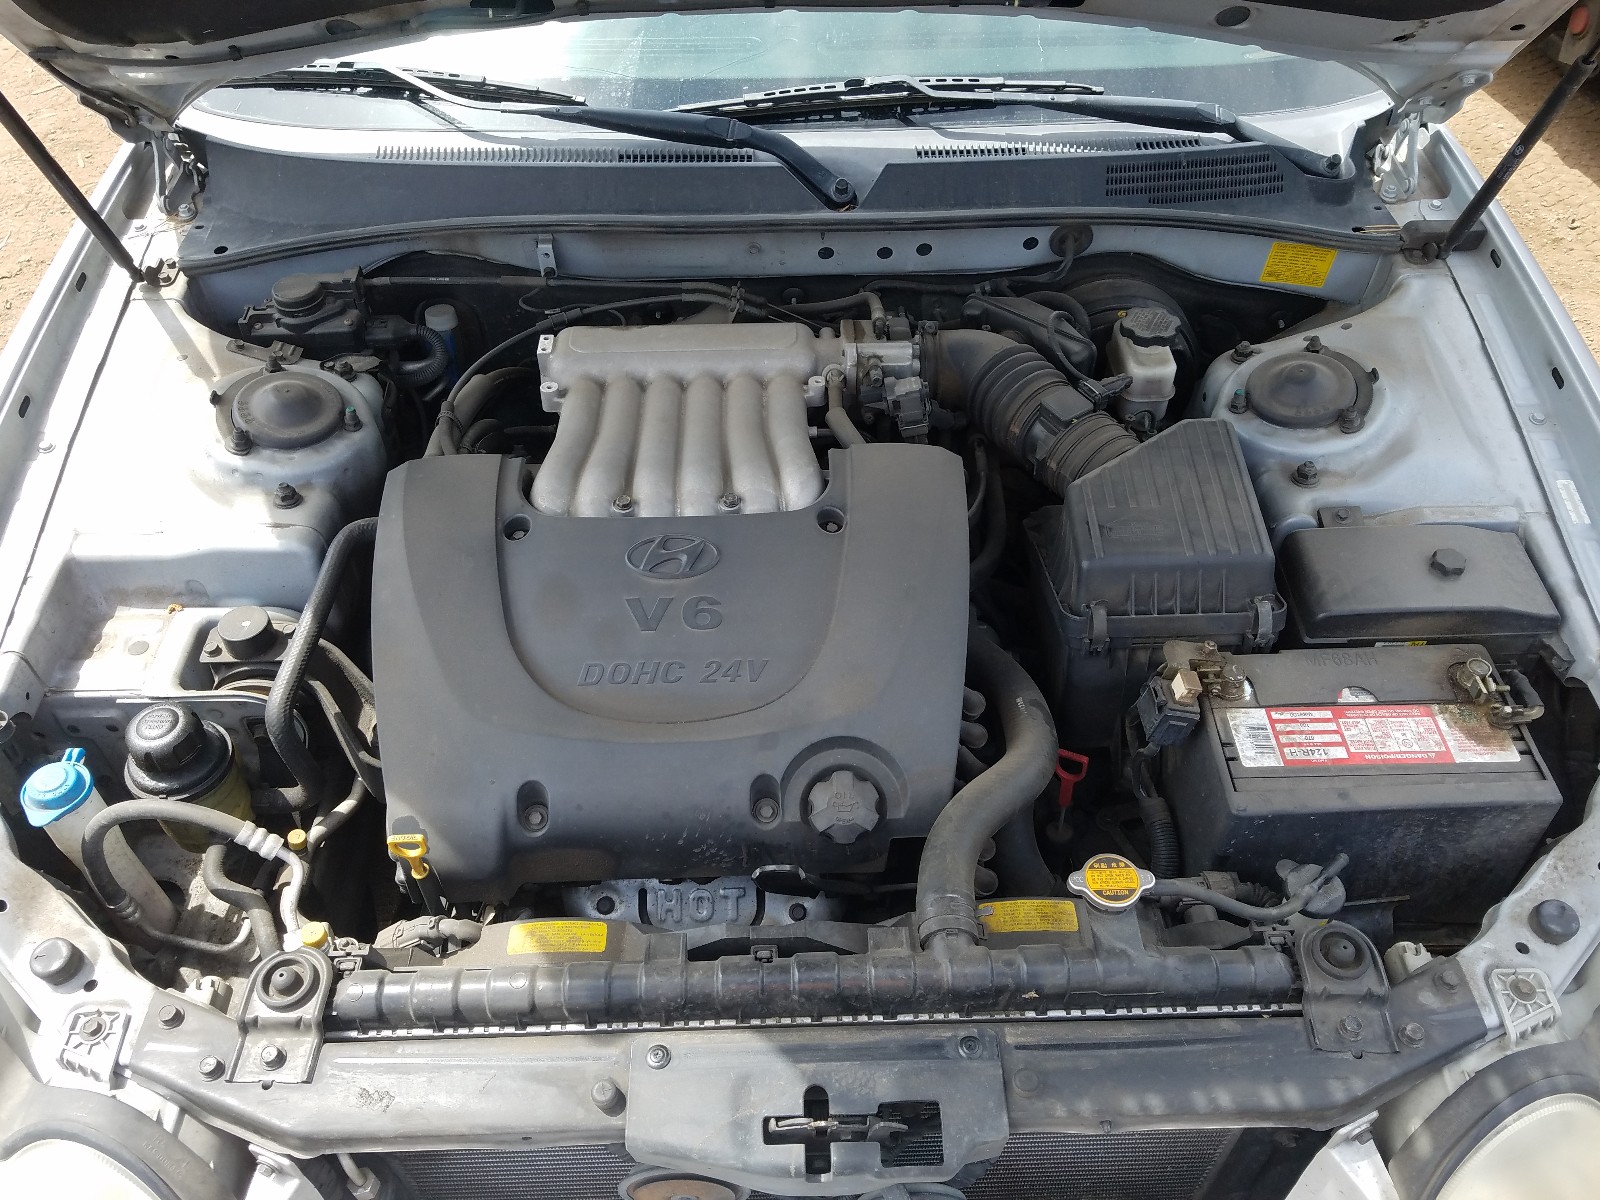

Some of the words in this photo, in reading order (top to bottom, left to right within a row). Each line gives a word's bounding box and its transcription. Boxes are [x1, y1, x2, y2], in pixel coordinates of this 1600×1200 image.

[624, 595, 723, 632] V6
[577, 660, 686, 687] DOHC
[699, 659, 769, 684] 24V
[657, 887, 746, 923] HOT
